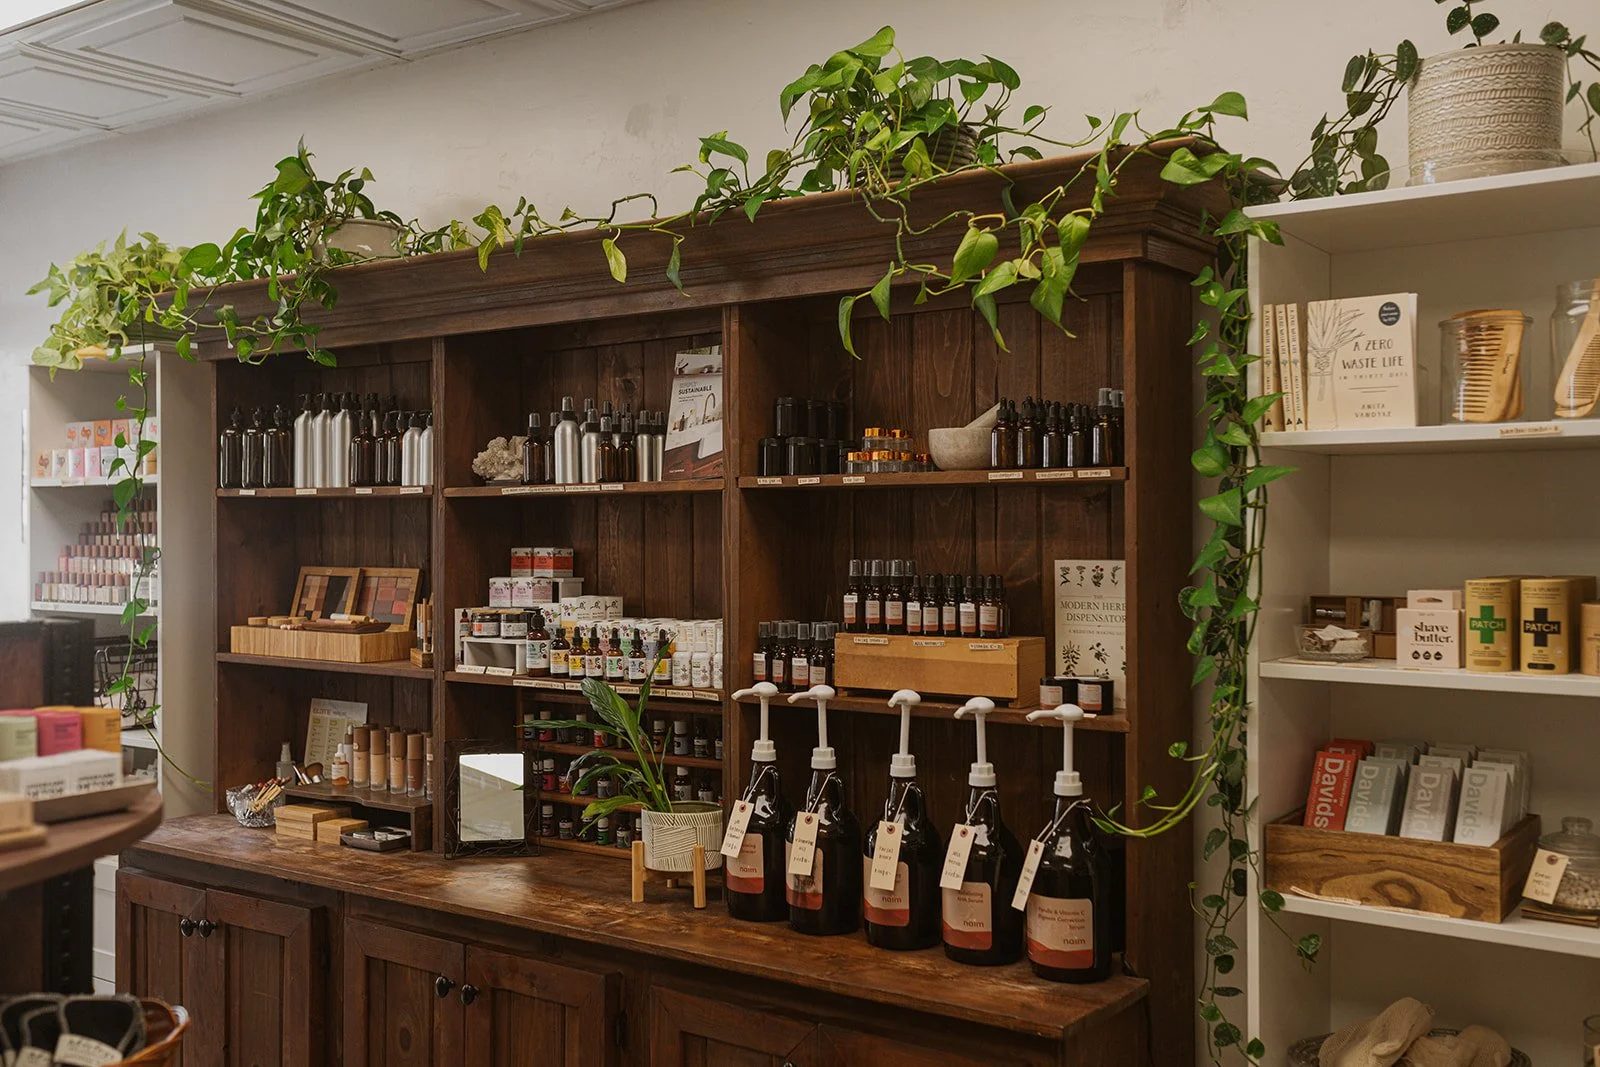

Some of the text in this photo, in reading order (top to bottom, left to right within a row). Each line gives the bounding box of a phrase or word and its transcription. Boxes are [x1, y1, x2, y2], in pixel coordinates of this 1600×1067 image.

[1353, 338, 1394, 351] A ZERO
[1342, 355, 1405, 370] WASTE LIFE
[679, 385, 712, 395] SUSTAINABLE
[1060, 600, 1100, 610] MODERN
[1414, 621, 1449, 633] shave
[1471, 620, 1504, 629] PATCH
[1525, 622, 1558, 632] PATCH
[1414, 632, 1454, 643] butter.
[1314, 758, 1344, 828] Davids
[1350, 765, 1379, 827] Davids
[1411, 773, 1441, 835] David
[1461, 773, 1487, 838] Davids
[881, 895, 901, 903] naim
[963, 920, 985, 928] naim
[1063, 937, 1086, 945] naim
